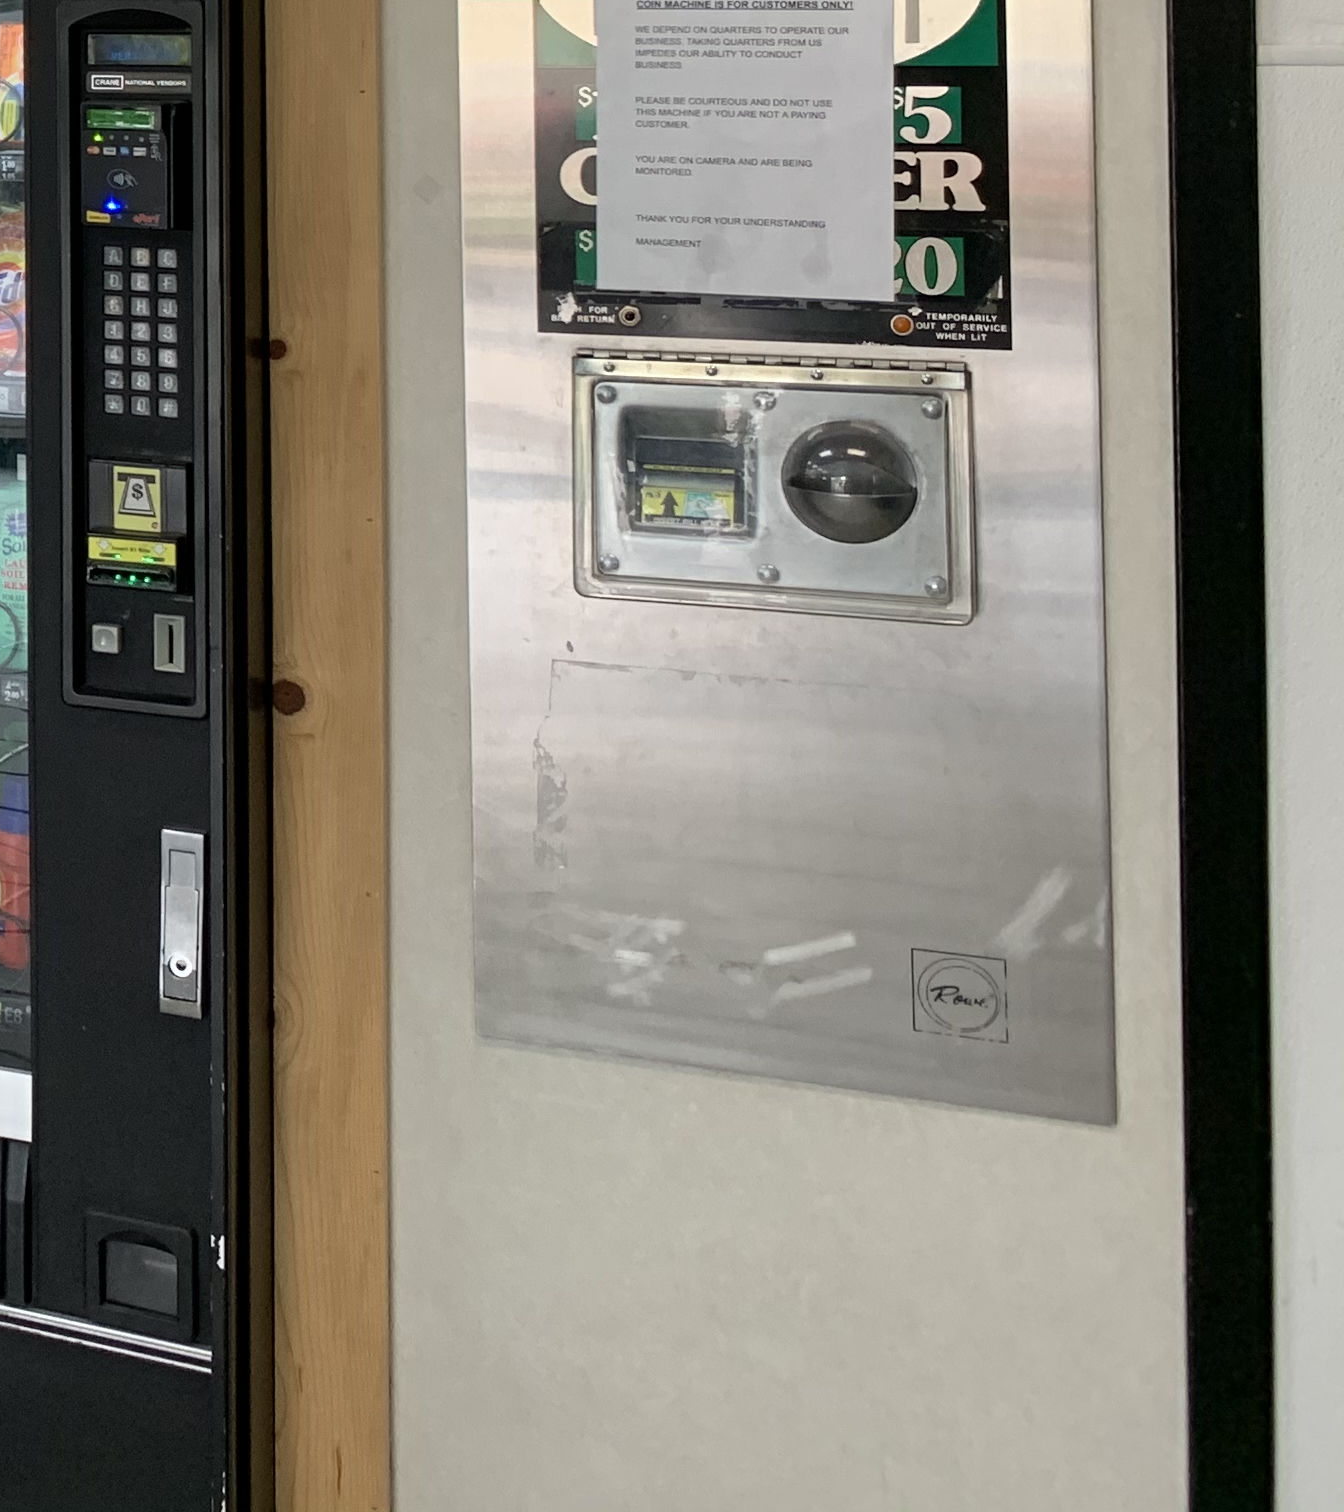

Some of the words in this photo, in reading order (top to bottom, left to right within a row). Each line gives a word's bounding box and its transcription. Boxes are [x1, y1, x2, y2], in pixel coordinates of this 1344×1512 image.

[637, 1, 661, 9] COIN
[664, 1, 711, 9] MACHINE
[715, 1, 724, 9] IS
[727, 1, 748, 9] FOR
[752, 1, 818, 10] CUSTOMERS
[821, 1, 854, 10] ONLY!
[710, 26, 761, 34] QUARTERS
[828, 27, 849, 35] OUR
[687, 38, 720, 46] TAKING
[723, 38, 775, 46] QUARTERS
[702, 50, 737, 58] ABILITY
[740, 50, 752, 58] TO
[695, 157, 735, 165] CAMERA
[738, 158, 758, 166] AND
[760, 158, 780, 166] ARE
[783, 159, 812, 167] BEING
[669, 215, 689, 223] YOU
[692, 216, 711, 224] FOR
[714, 217, 741, 225] YOUR
[743, 218, 826, 228] UNDERSTANDING
[636, 238, 701, 247] MANAGEMENT
[577, 315, 615, 323] RETURN
[926, 313, 997, 322] TEMPORARILY
[963, 324, 1007, 332] SERVICE
[971, 333, 987, 341] LIT
